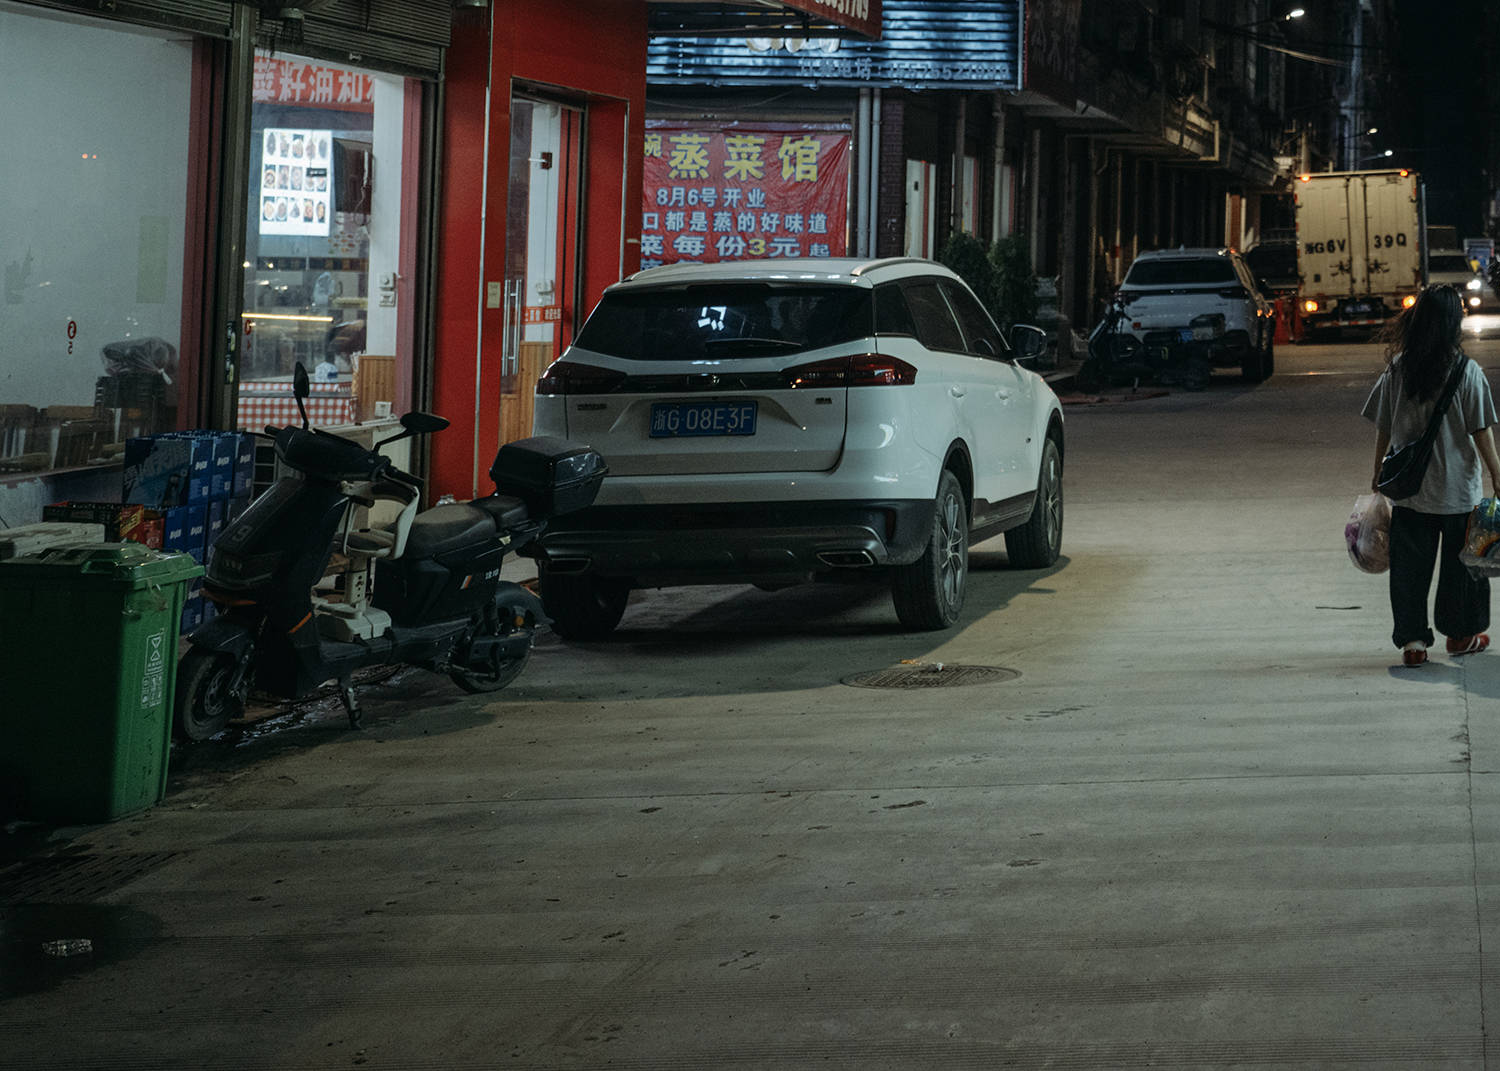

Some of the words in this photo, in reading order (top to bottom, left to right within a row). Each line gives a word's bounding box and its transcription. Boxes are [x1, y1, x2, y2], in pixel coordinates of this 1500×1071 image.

[656, 186, 766, 209] 8月6号开业
[1373, 232, 1408, 249] 39Q
